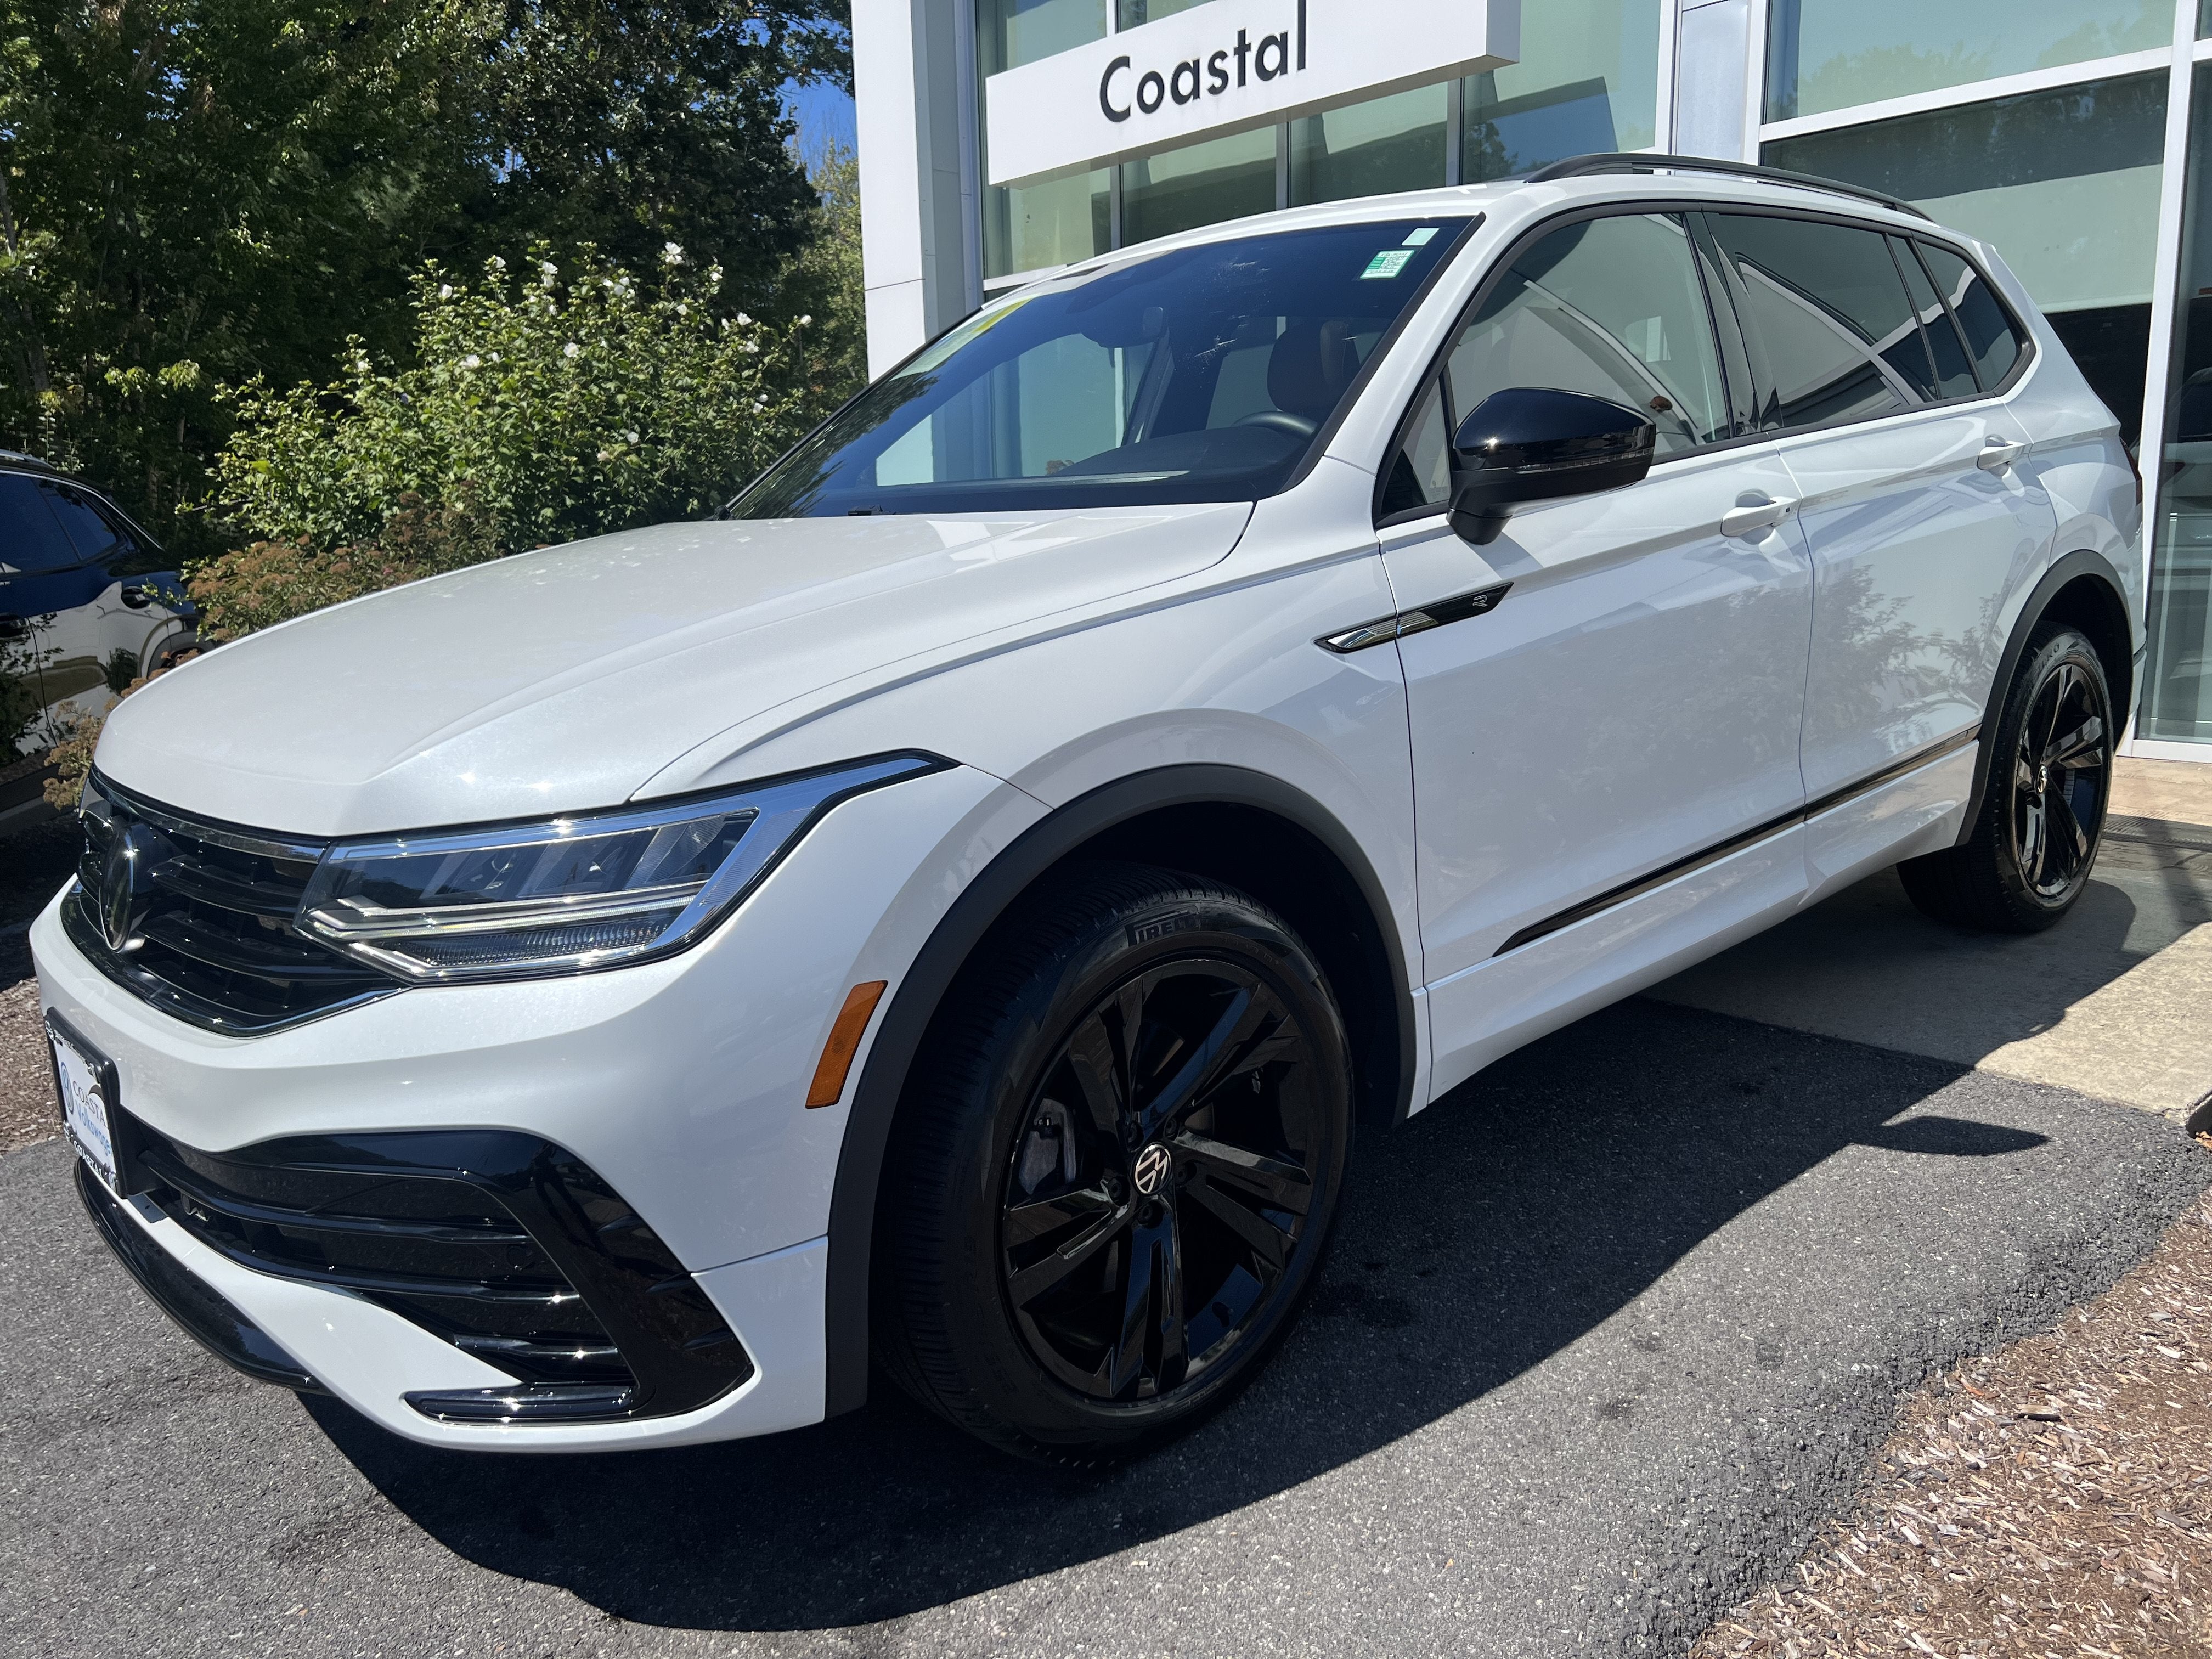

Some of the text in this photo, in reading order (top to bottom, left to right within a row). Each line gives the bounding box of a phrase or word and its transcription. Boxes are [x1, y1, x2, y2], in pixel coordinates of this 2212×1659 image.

[1099, 0, 1307, 123] Coastal
[1472, 594, 1488, 607] R
[72, 1080, 108, 1128] COASTA
[75, 1098, 111, 1156] Volkswage
